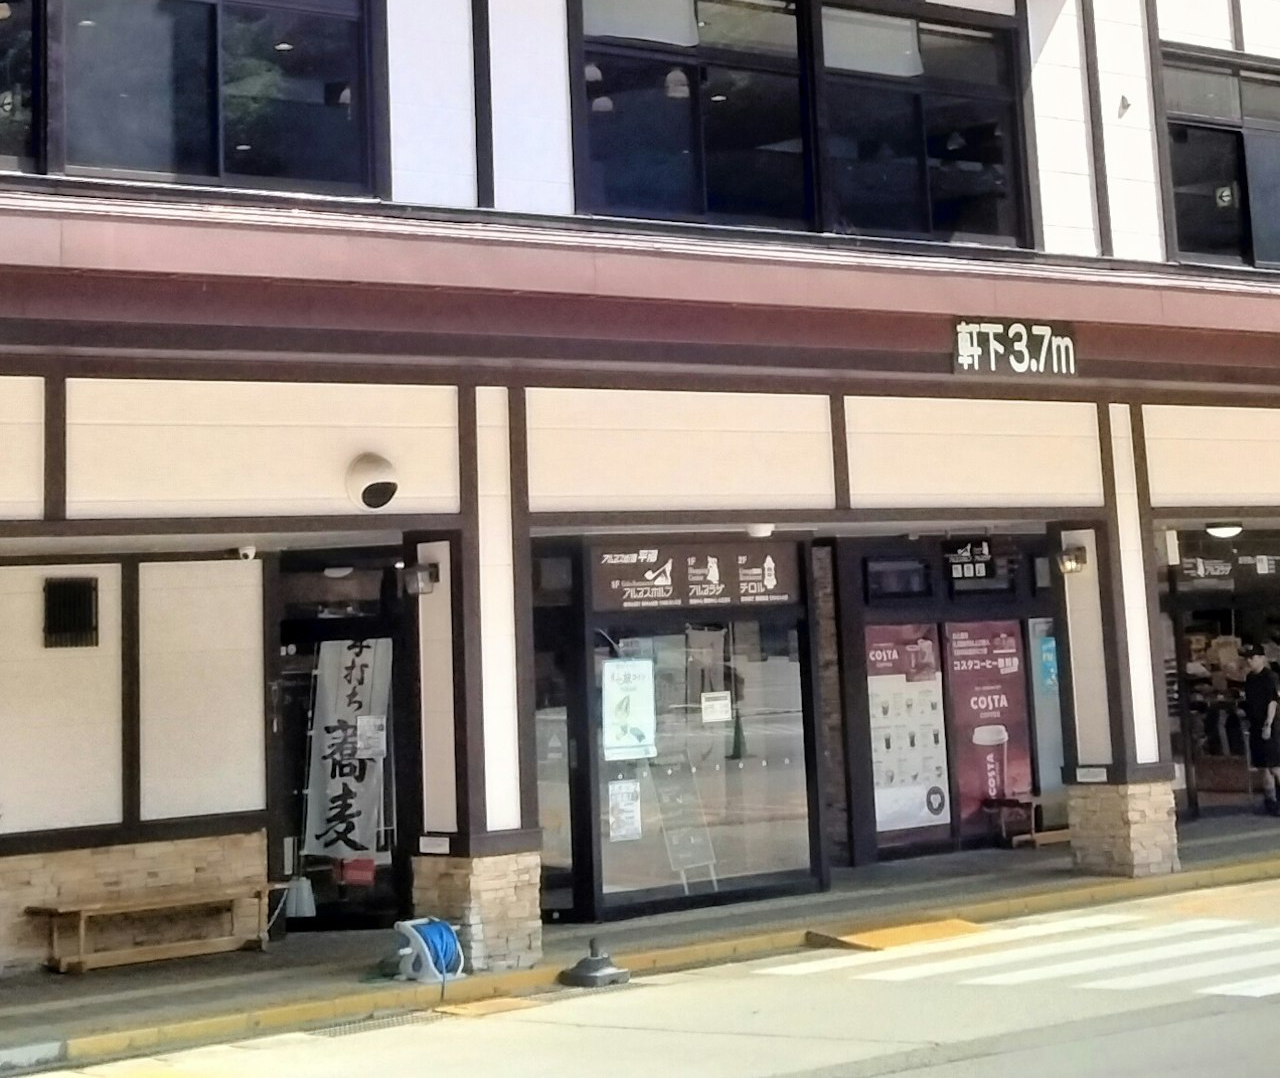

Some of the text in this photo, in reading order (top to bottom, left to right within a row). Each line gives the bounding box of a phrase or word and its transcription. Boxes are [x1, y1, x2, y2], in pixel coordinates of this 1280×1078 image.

[739, 582, 766, 594] チロル
[869, 648, 899, 662] COSTA
[970, 694, 1008, 710] COSTA
